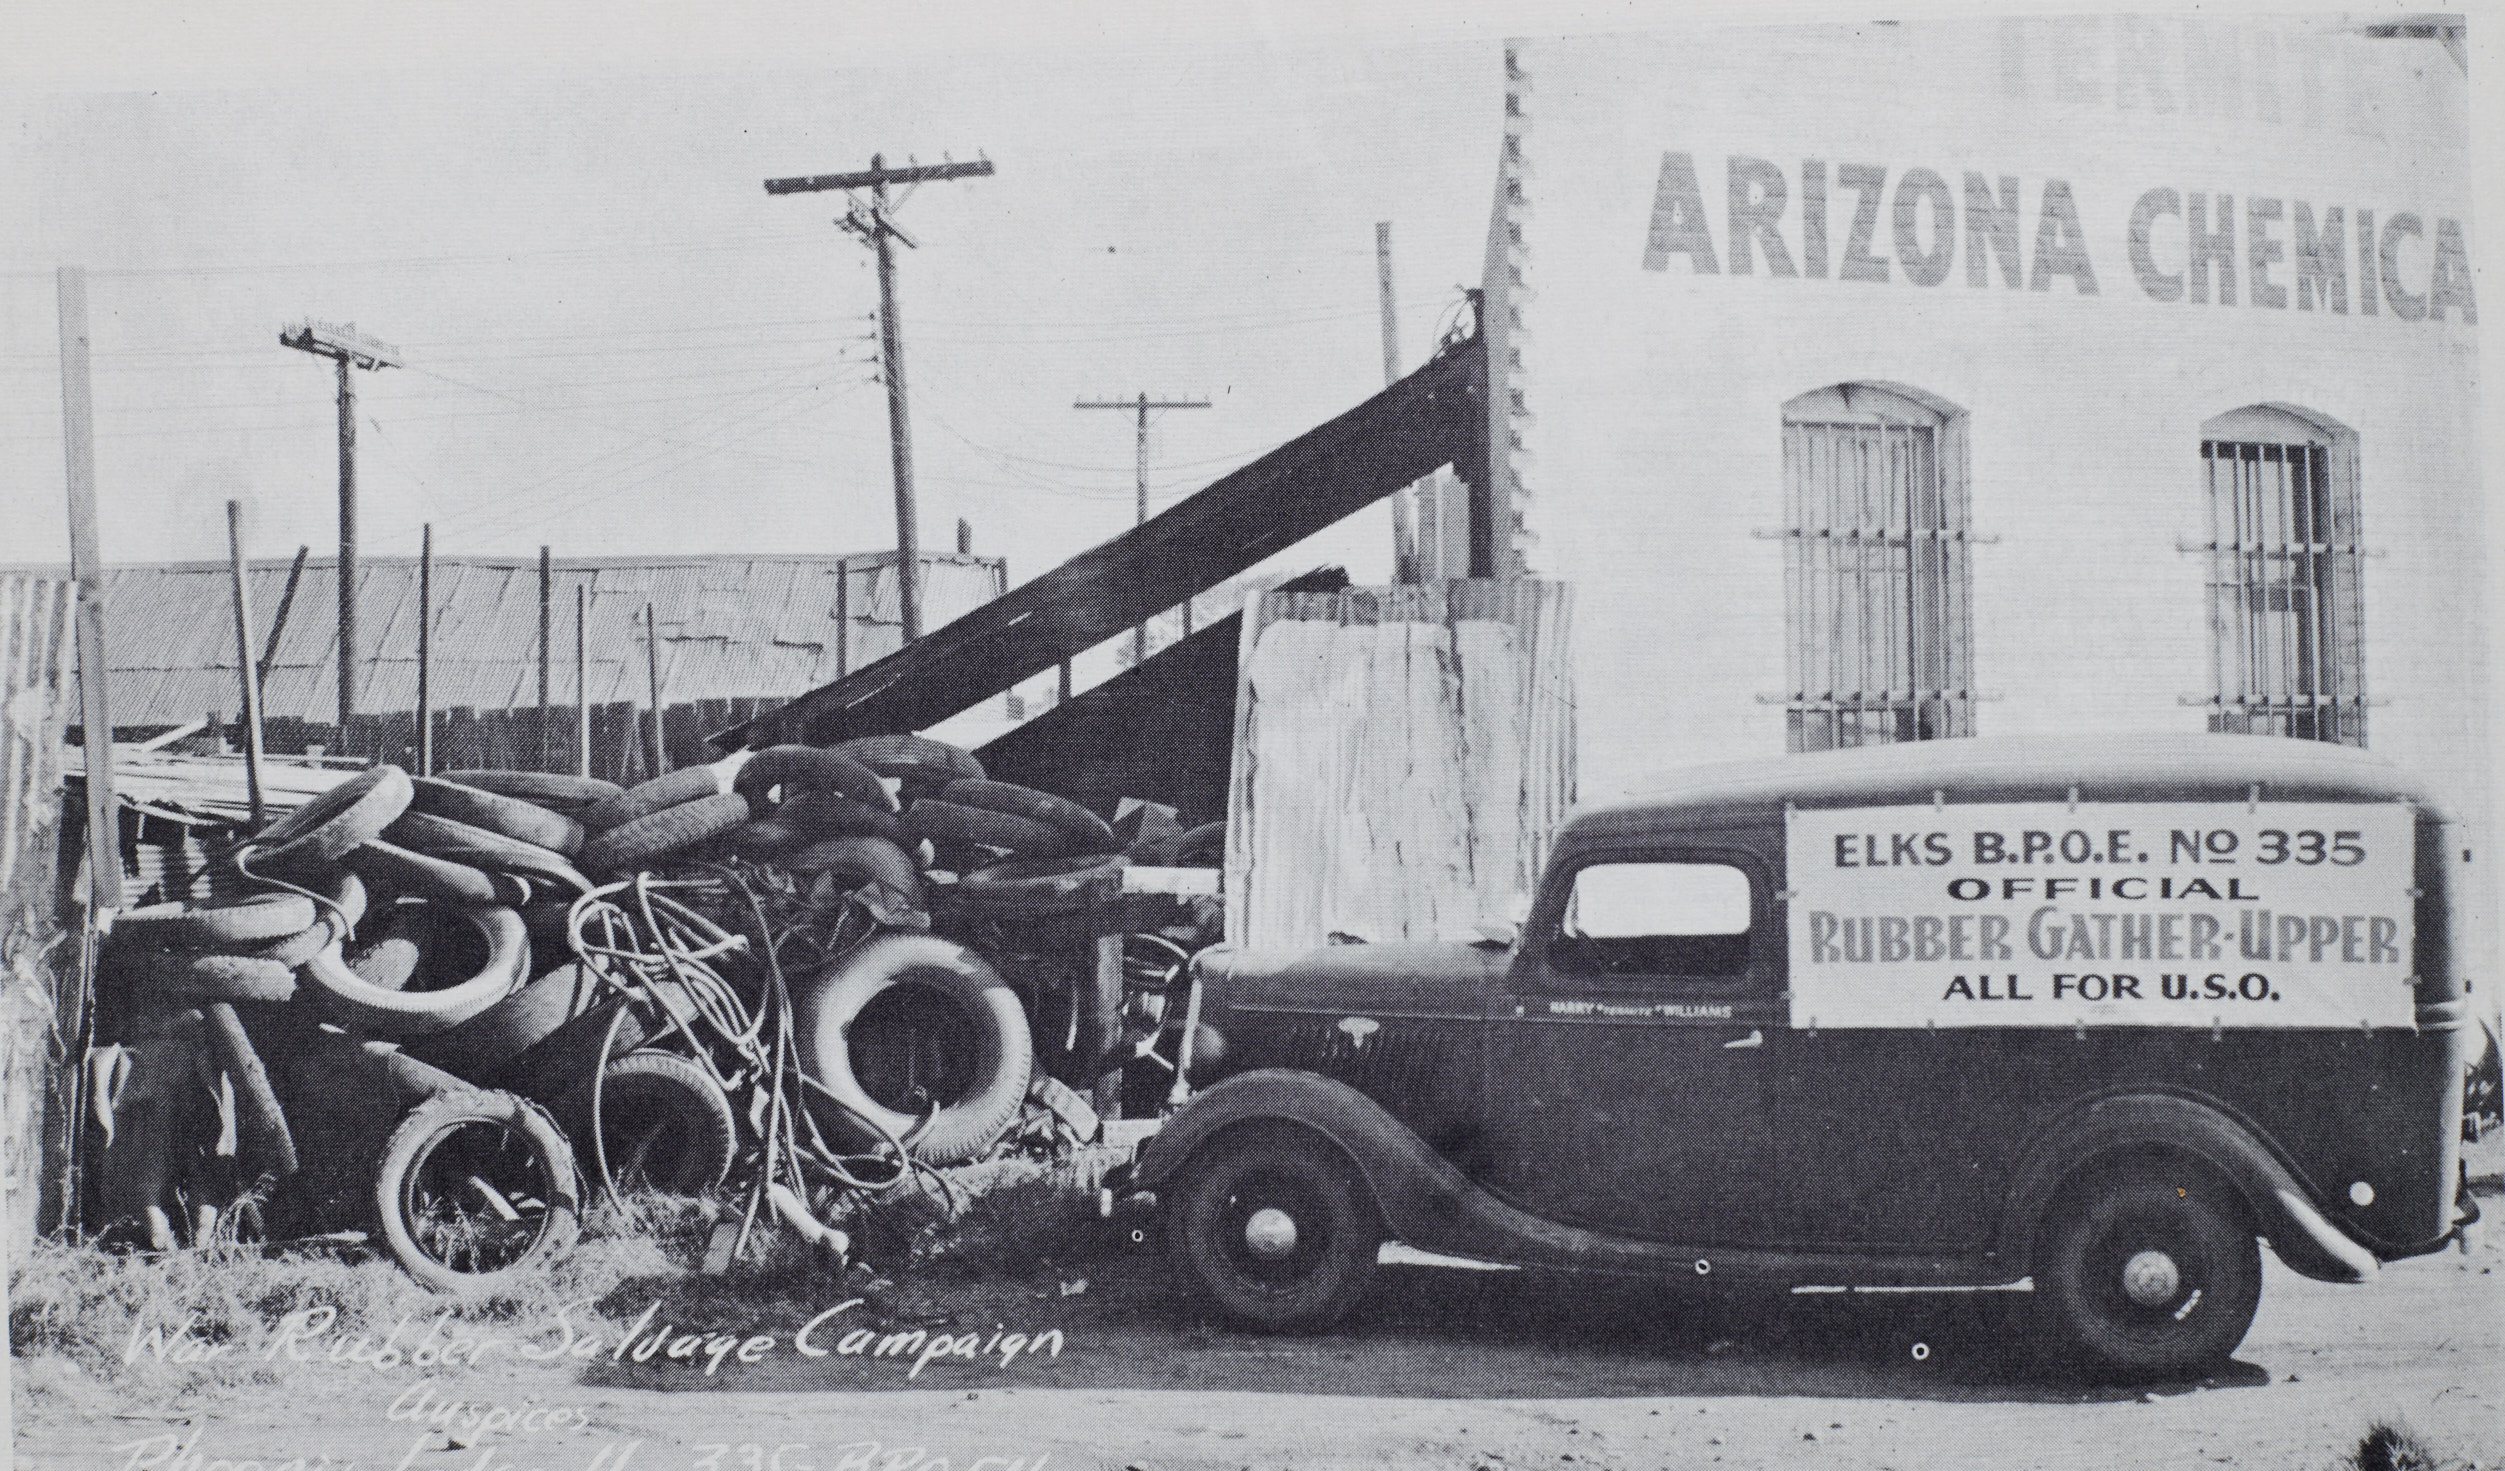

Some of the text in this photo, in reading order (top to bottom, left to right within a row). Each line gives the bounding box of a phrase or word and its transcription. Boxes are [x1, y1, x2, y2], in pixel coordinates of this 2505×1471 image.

[1642, 150, 2479, 327] ARIZONA CHEMICA
[1834, 832, 1953, 867] ELKS
[1973, 829, 2149, 866] B.P.O.E.
[2256, 829, 2367, 867] 335
[1946, 877, 2260, 900] OFFICIAL
[1808, 906, 2401, 964] RUBBER GATHER-UPPER
[1942, 973, 2281, 1001] ALL FOR U.S.O.
[1549, 1000, 1595, 1015] HARRY
[1663, 1004, 1733, 1019] WILLIAMS
